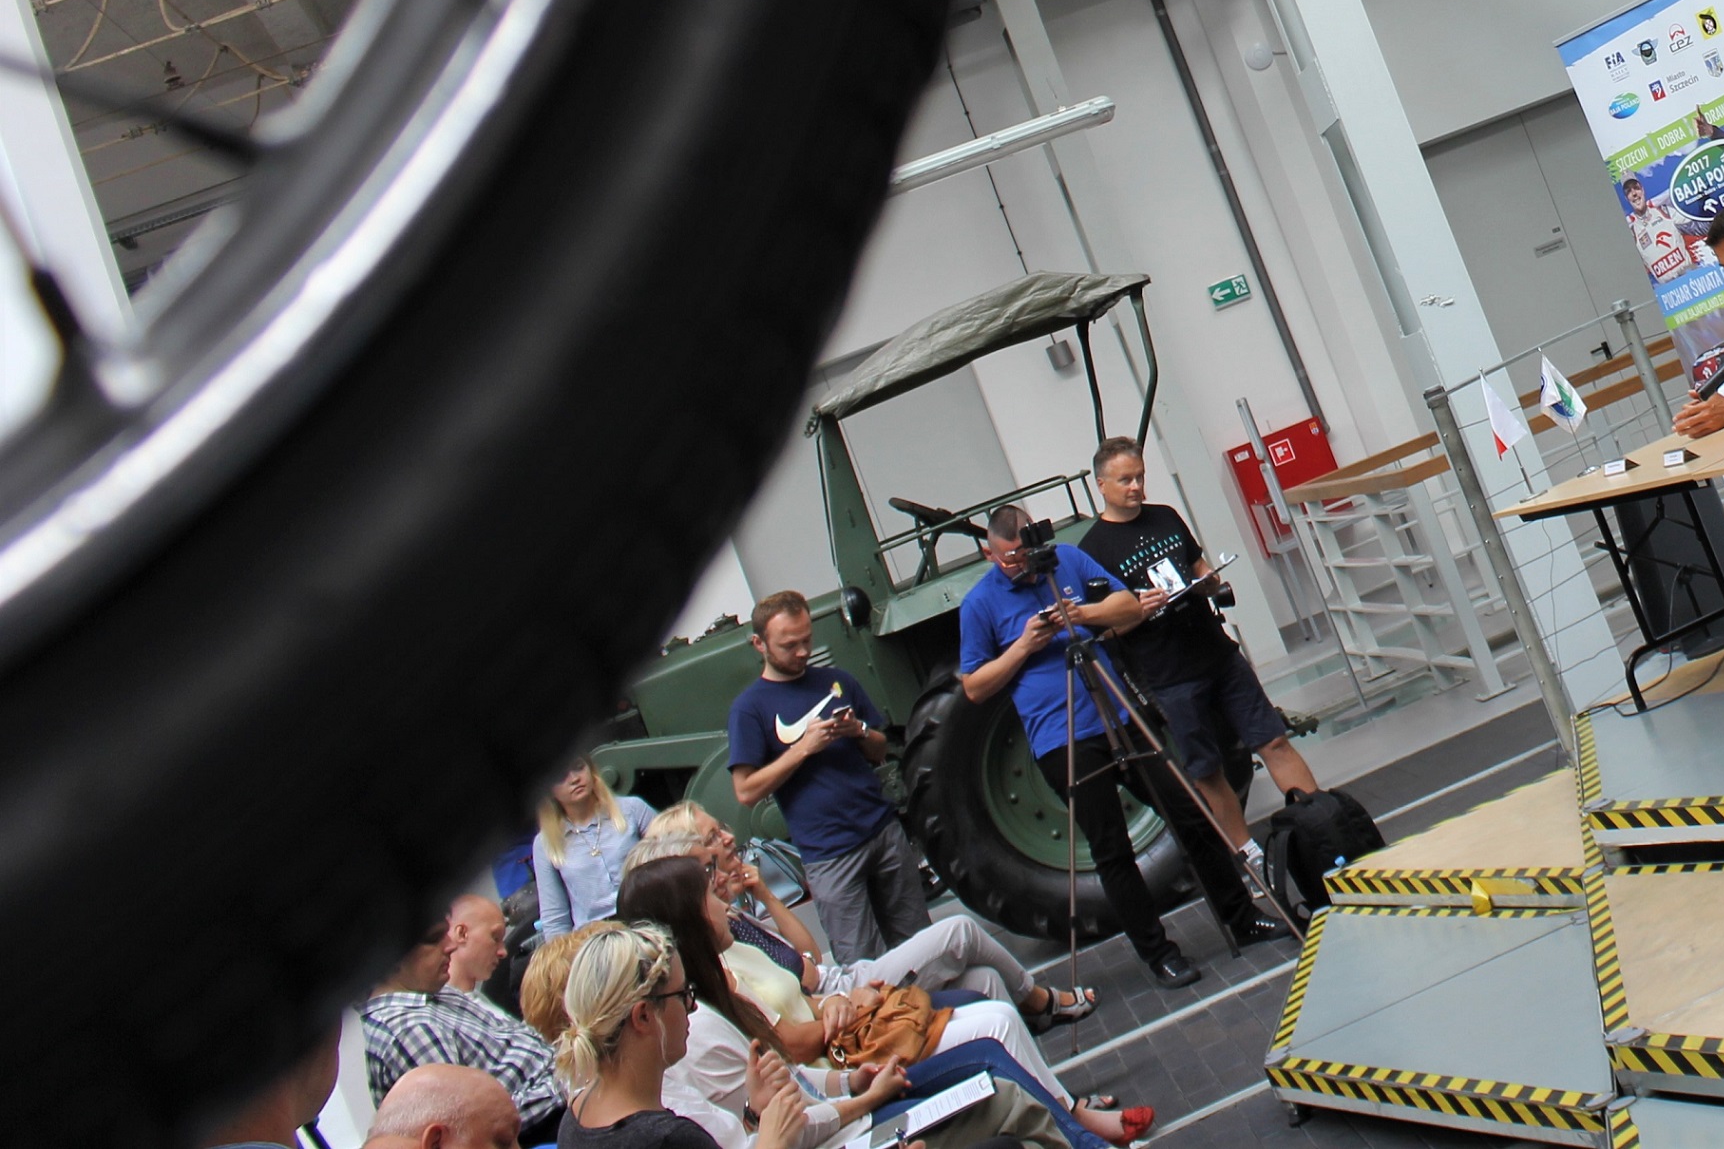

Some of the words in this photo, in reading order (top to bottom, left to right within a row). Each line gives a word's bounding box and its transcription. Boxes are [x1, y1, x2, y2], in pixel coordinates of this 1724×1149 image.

[1666, 70, 1686, 84] Miasto
[1669, 74, 1700, 93] Szczecin
[1615, 146, 1649, 172] SZCZECIN
[1657, 126, 1687, 150] DOBRA
[1685, 155, 1710, 178] 2017
[1673, 175, 1707, 203] BAJA
[1653, 251, 1682, 276] ORLEN
[1661, 284, 1692, 310] PUCHAR
[1690, 271, 1723, 298] ŚWIATA
